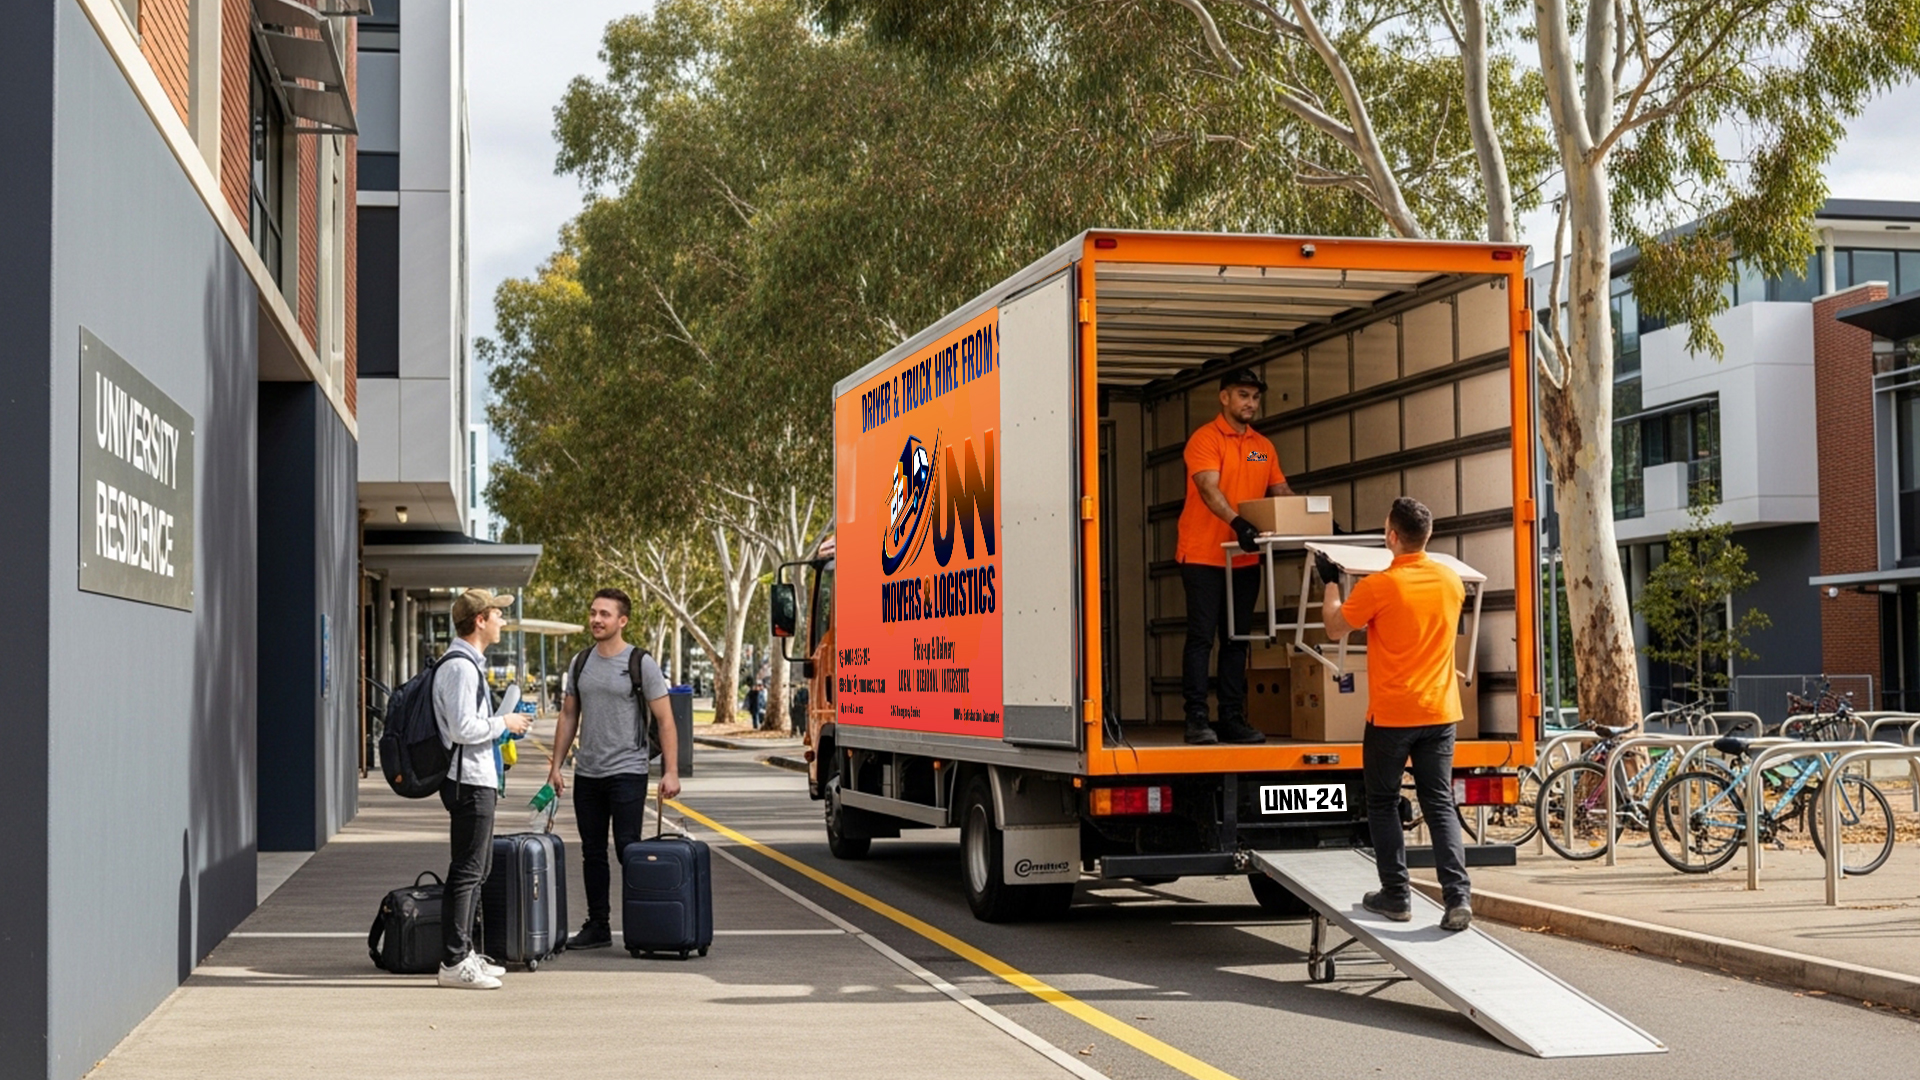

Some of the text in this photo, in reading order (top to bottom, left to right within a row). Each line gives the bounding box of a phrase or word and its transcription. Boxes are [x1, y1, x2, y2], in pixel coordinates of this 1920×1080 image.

[862, 380, 891, 433] DRIVER
[893, 376, 900, 418] &
[902, 357, 933, 414] TRUCK
[934, 342, 959, 398] HIRE
[961, 324, 993, 385] FROM
[96, 371, 179, 490] UNIVERSITY
[96, 480, 174, 577] RESIDENCE
[882, 563, 996, 623] MOVERS & LOGISTICS
[1264, 787, 1345, 811] UNN-24
